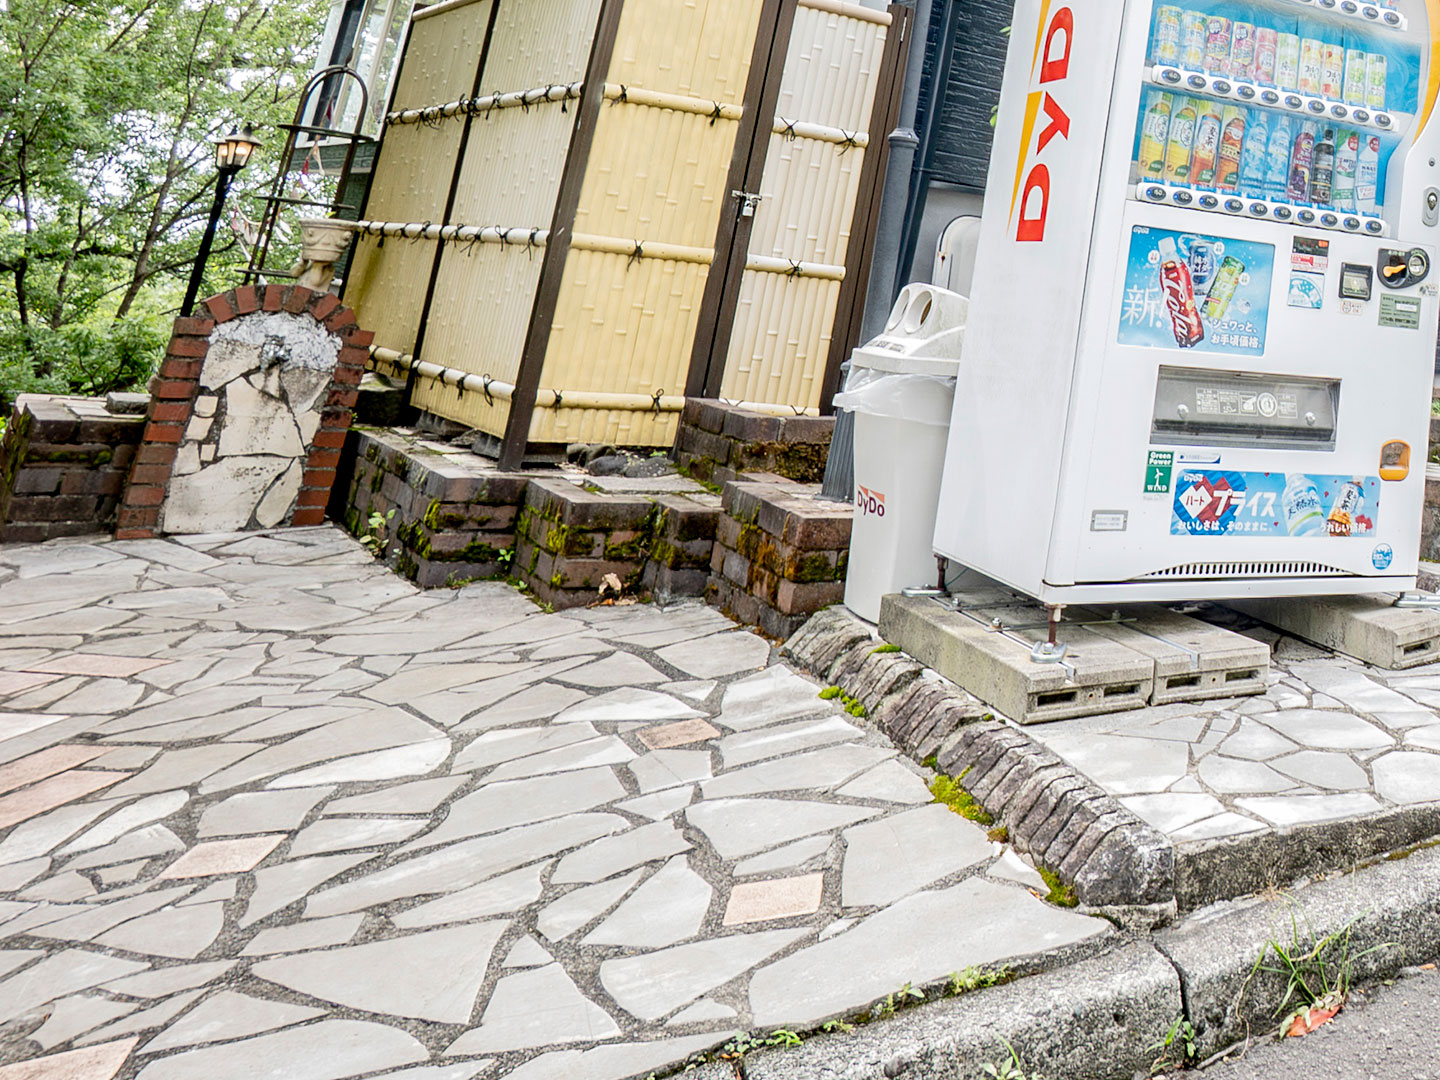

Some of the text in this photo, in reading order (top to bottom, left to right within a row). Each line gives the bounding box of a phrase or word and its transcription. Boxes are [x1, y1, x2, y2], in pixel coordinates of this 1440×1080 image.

[1147, 484, 1168, 492] WIND
[1184, 473, 1204, 483] DyDo
[858, 490, 885, 517] DyDo
[1185, 488, 1277, 518] ハート プライス
[1340, 488, 1353, 511] 麦茶
